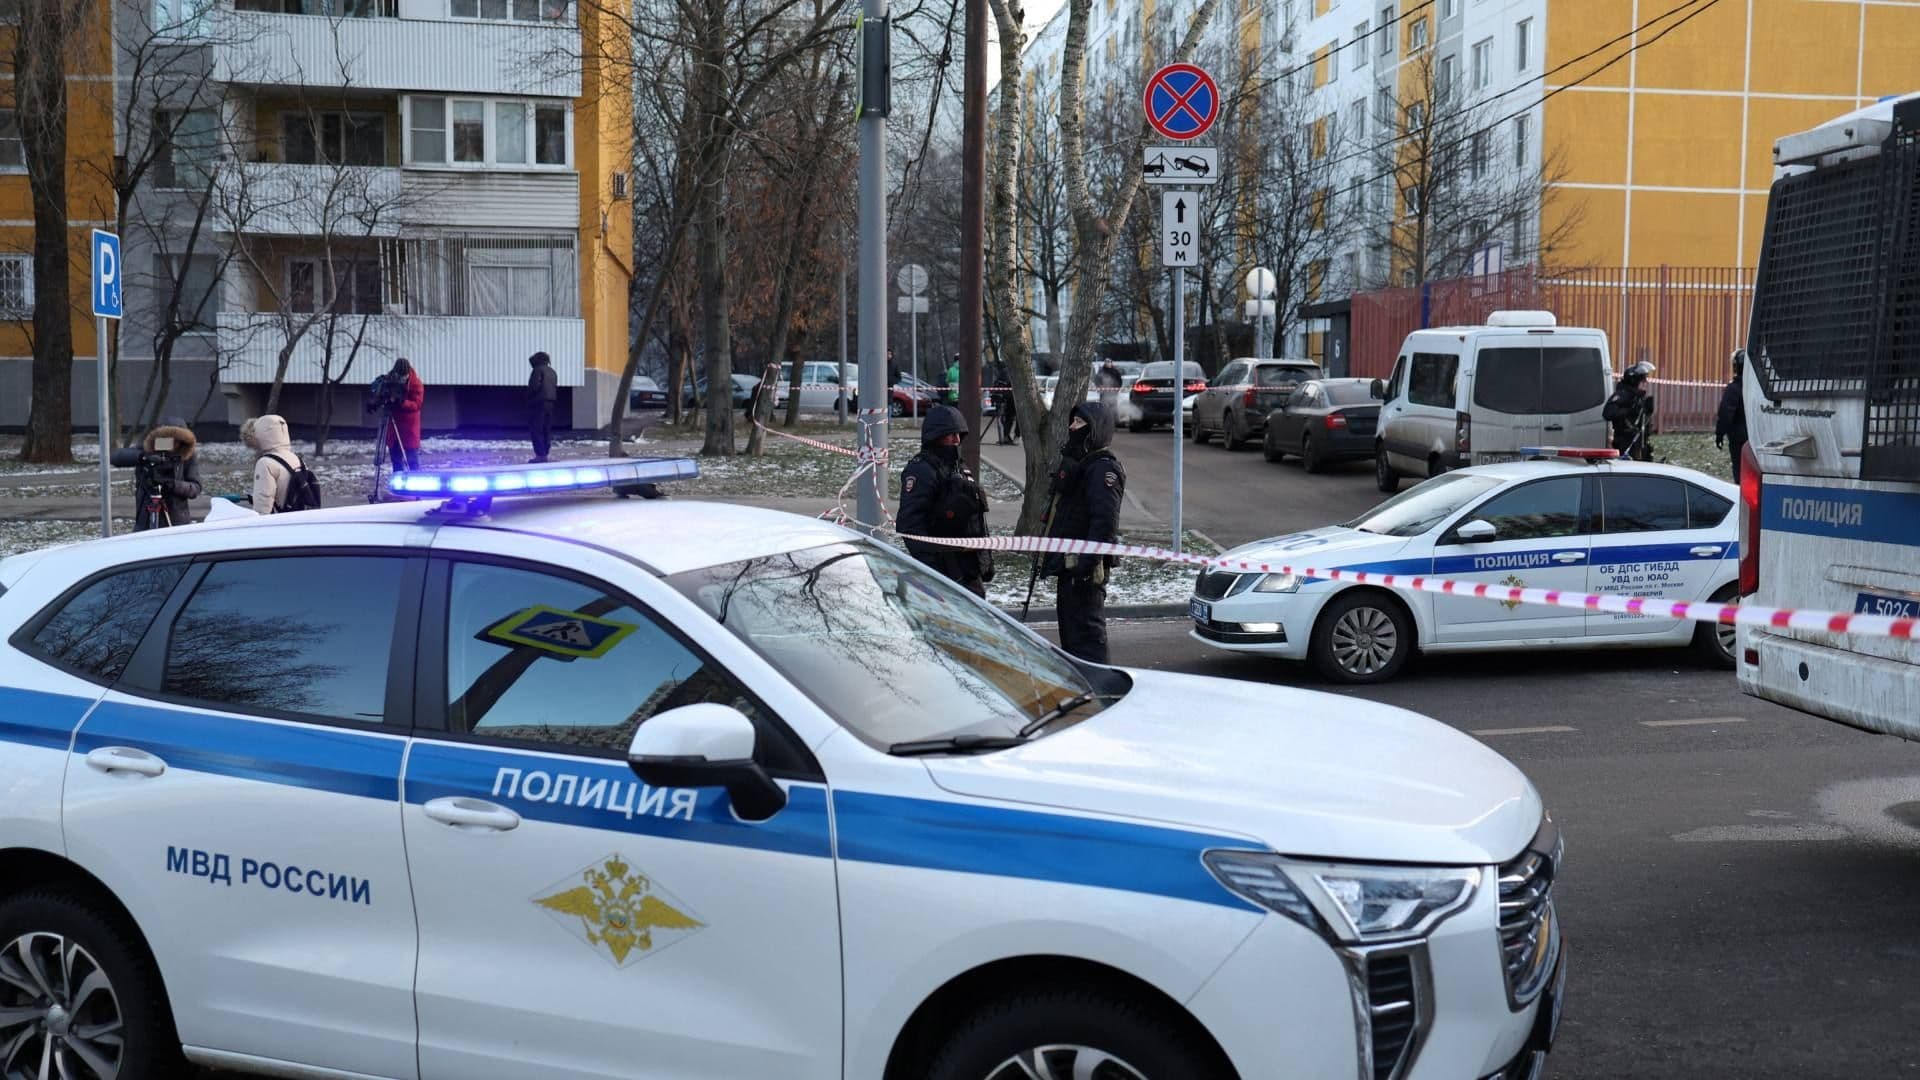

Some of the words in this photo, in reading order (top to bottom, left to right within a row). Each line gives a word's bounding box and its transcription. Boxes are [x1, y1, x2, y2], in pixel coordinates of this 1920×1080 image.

[1170, 231, 1191, 246] 30
[101, 242, 115, 306] P
[1782, 497, 1863, 528] ПОЛИЦИЯ
[1474, 553, 1550, 569] ПОЛИЦИЯ
[1600, 565, 1614, 574] ОБ
[1618, 564, 1640, 574] ДПС
[1644, 562, 1680, 572] ГИБДД
[1611, 575, 1630, 584] УВД
[1647, 573, 1669, 582] ЮАО
[492, 768, 698, 821] ПОЛИЦИЯ
[167, 846, 231, 886] МВД
[242, 858, 371, 905] РОССИИ
